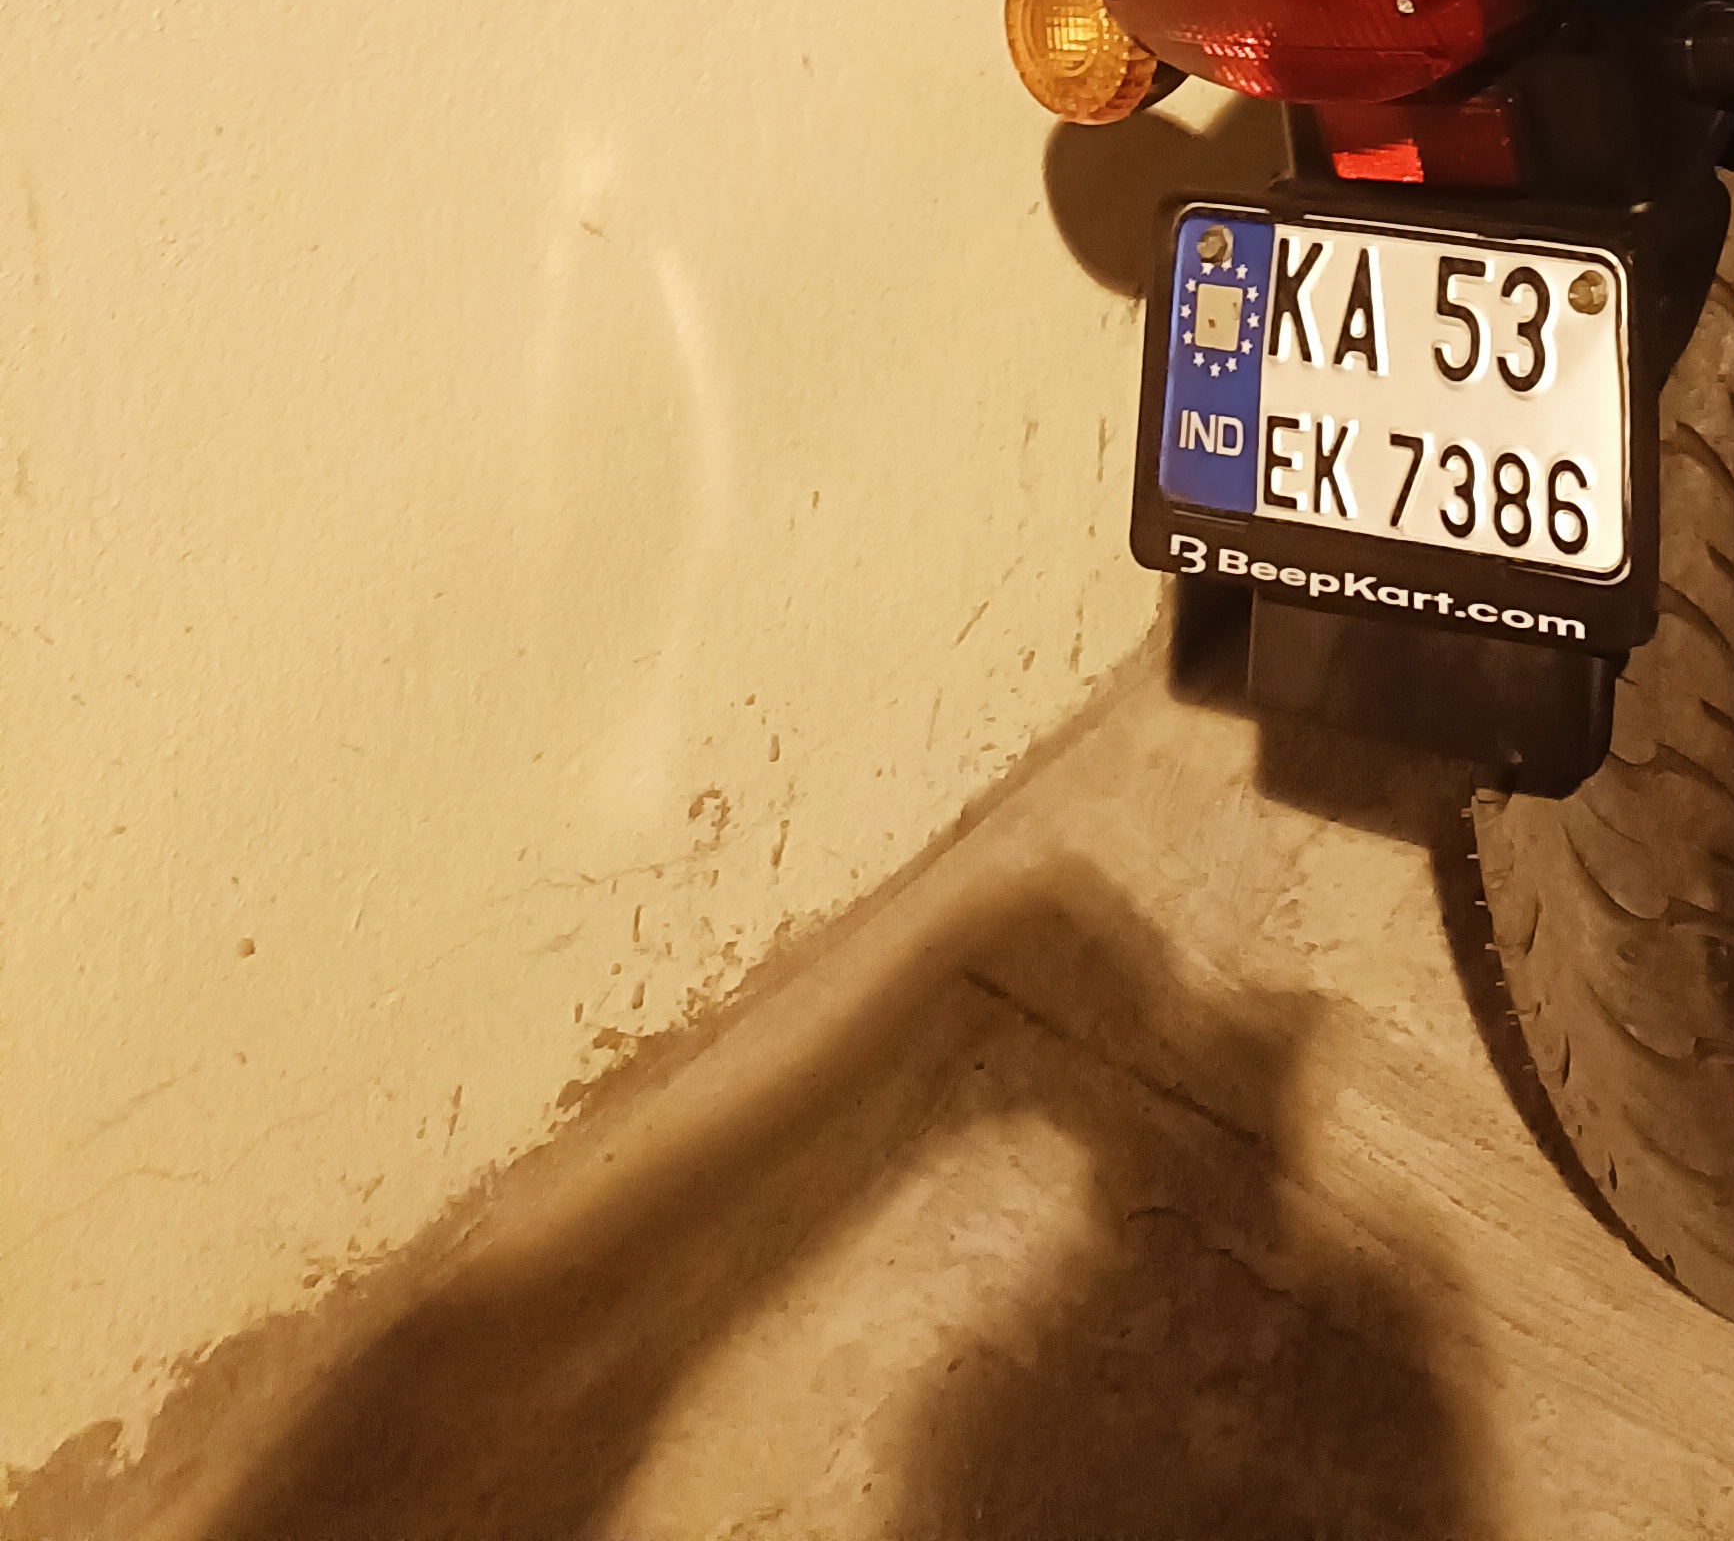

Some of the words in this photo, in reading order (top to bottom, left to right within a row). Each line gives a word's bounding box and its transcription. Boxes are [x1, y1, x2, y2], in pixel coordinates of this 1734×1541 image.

[1268, 237, 1380, 374] KA
[1433, 255, 1552, 393] 53
[1179, 409, 1244, 457] IND
[1264, 415, 1350, 518] EK
[1389, 432, 1591, 555] 7386
[1217, 546, 1588, 640] BeepKart.com
